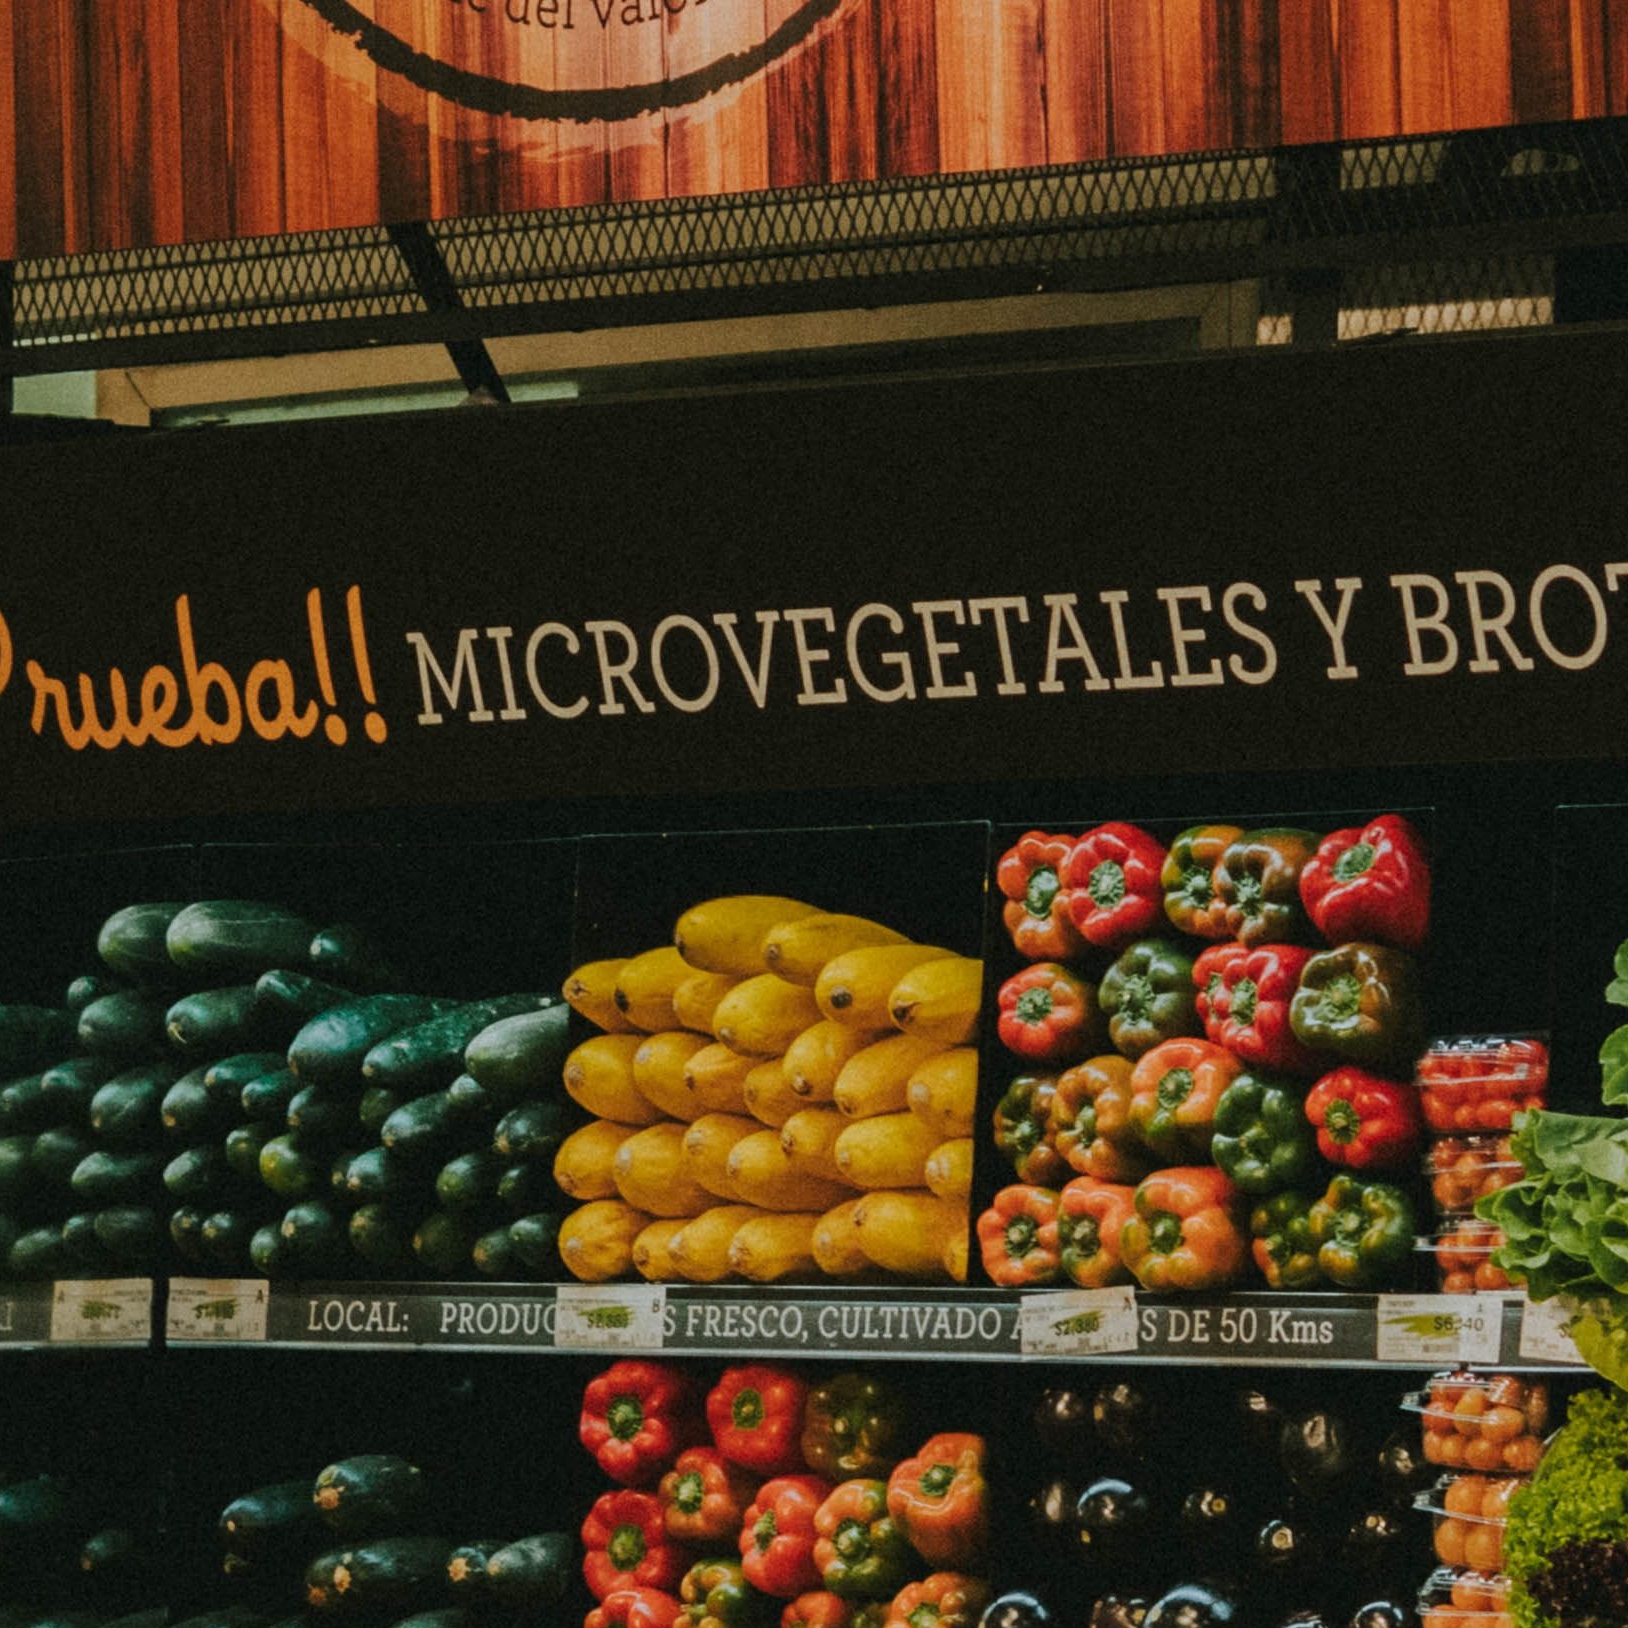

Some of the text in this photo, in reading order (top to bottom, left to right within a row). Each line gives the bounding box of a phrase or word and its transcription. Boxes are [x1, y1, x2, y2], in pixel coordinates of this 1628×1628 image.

[406, 581, 1277, 725] MICROVEGETALES
[1294, 578, 1363, 681] Y
[307, 1300, 409, 1332] LOCAL:
[686, 1305, 809, 1342] FRESCO,
[818, 1306, 1002, 1340] CULTIVADO
[1168, 1310, 1210, 1343] DE
[1220, 1309, 1258, 1343] 50
[1268, 1311, 1334, 1345] Kms
